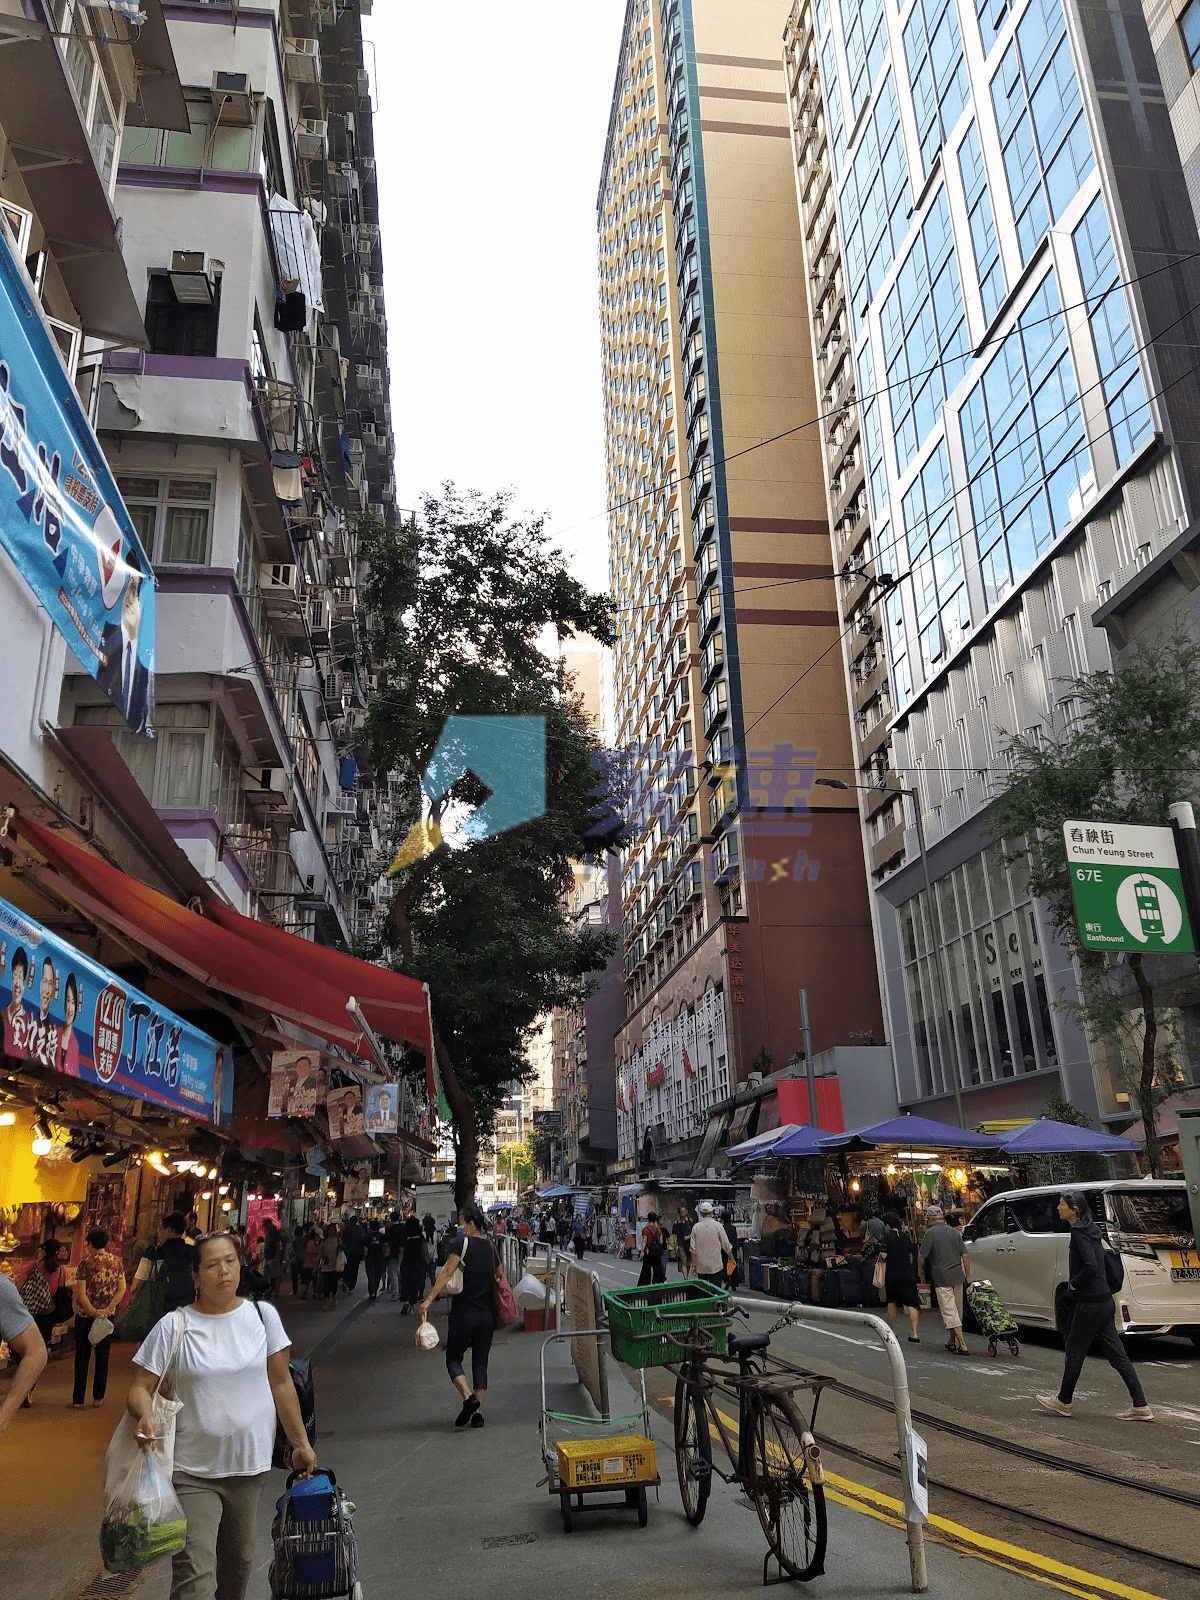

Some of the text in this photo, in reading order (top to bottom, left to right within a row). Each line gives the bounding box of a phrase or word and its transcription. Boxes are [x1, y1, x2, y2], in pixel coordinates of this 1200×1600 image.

[1069, 827, 1114, 845] 春秧街
[1072, 845, 1154, 859] Chun Yeung Street
[1076, 869, 1103, 883] 67E
[1085, 922, 1101, 933] 東行
[1086, 933, 1124, 943] Eastbound
[728, 924, 745, 1004] 华美达酒店
[99, 989, 126, 1031] 12.10
[98, 1026, 119, 1054] 請投票
[98, 1052, 114, 1075] 支持
